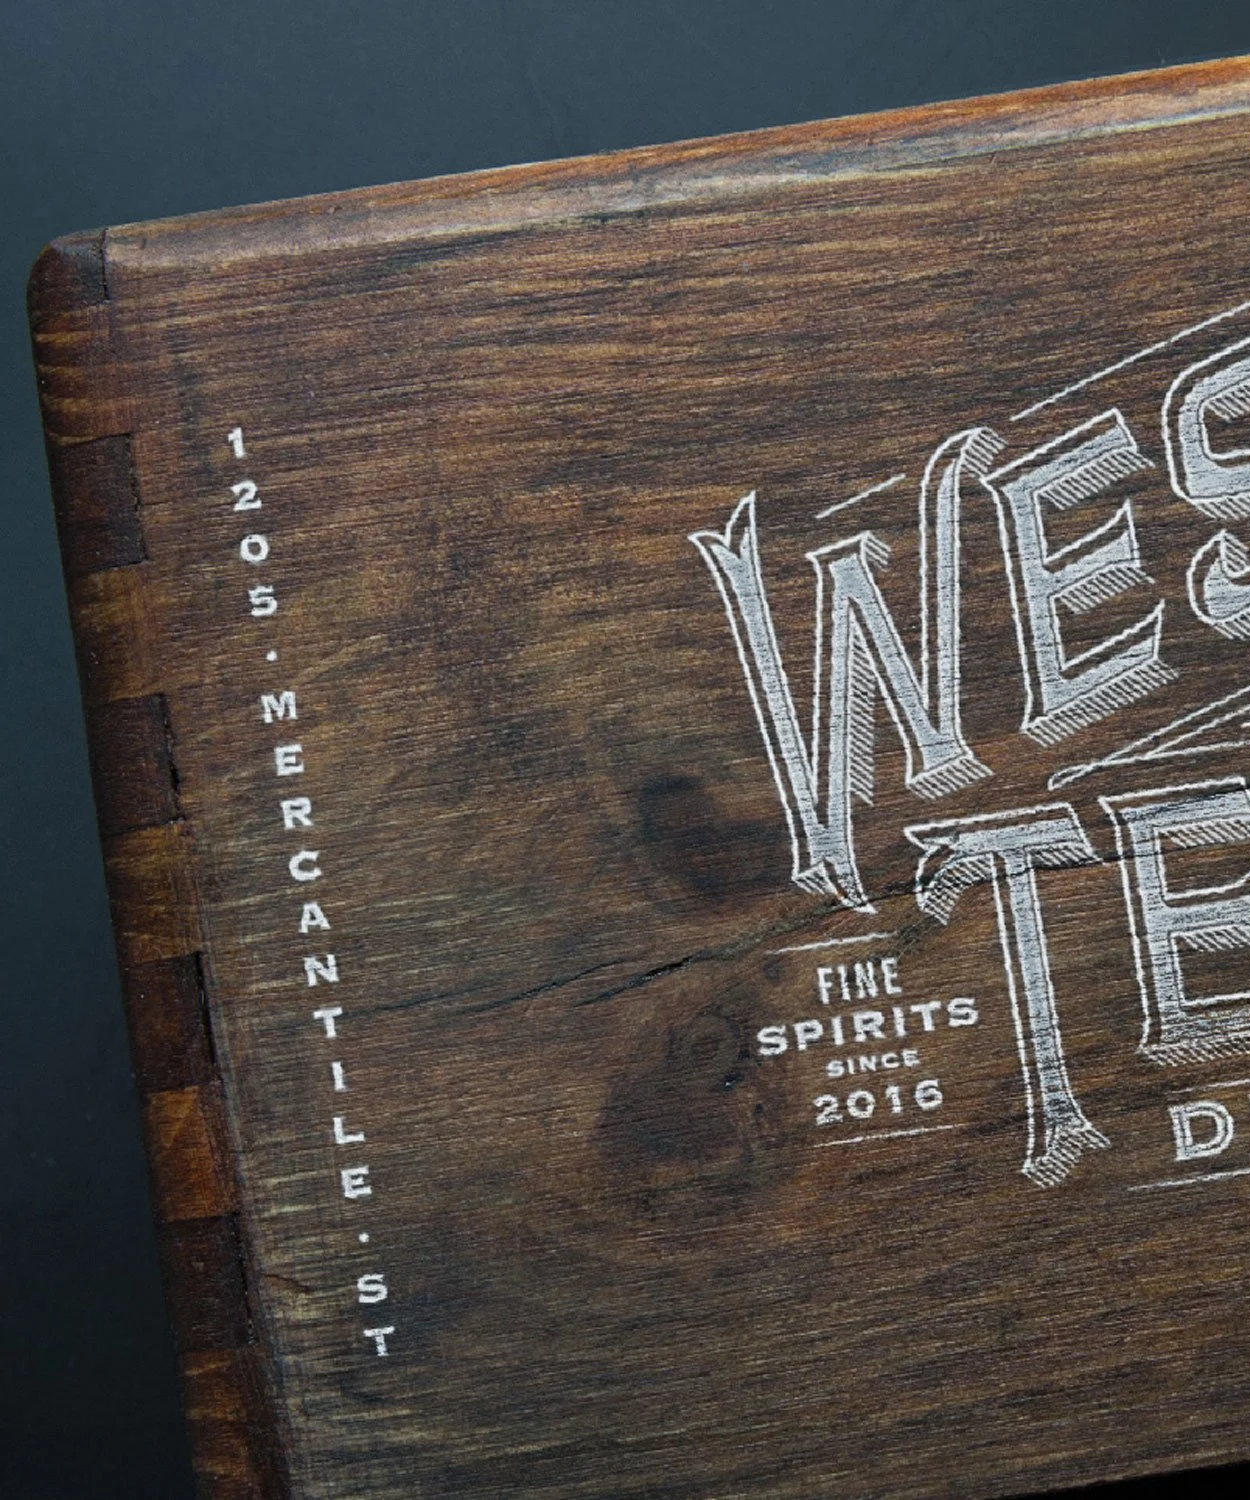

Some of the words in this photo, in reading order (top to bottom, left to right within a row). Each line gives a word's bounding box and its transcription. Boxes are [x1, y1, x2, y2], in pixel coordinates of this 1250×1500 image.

[816, 957, 902, 1005] FINE
[756, 997, 979, 1056] SPIRITS
[825, 1049, 921, 1078] SINCE
[813, 1079, 944, 1126] 2016
